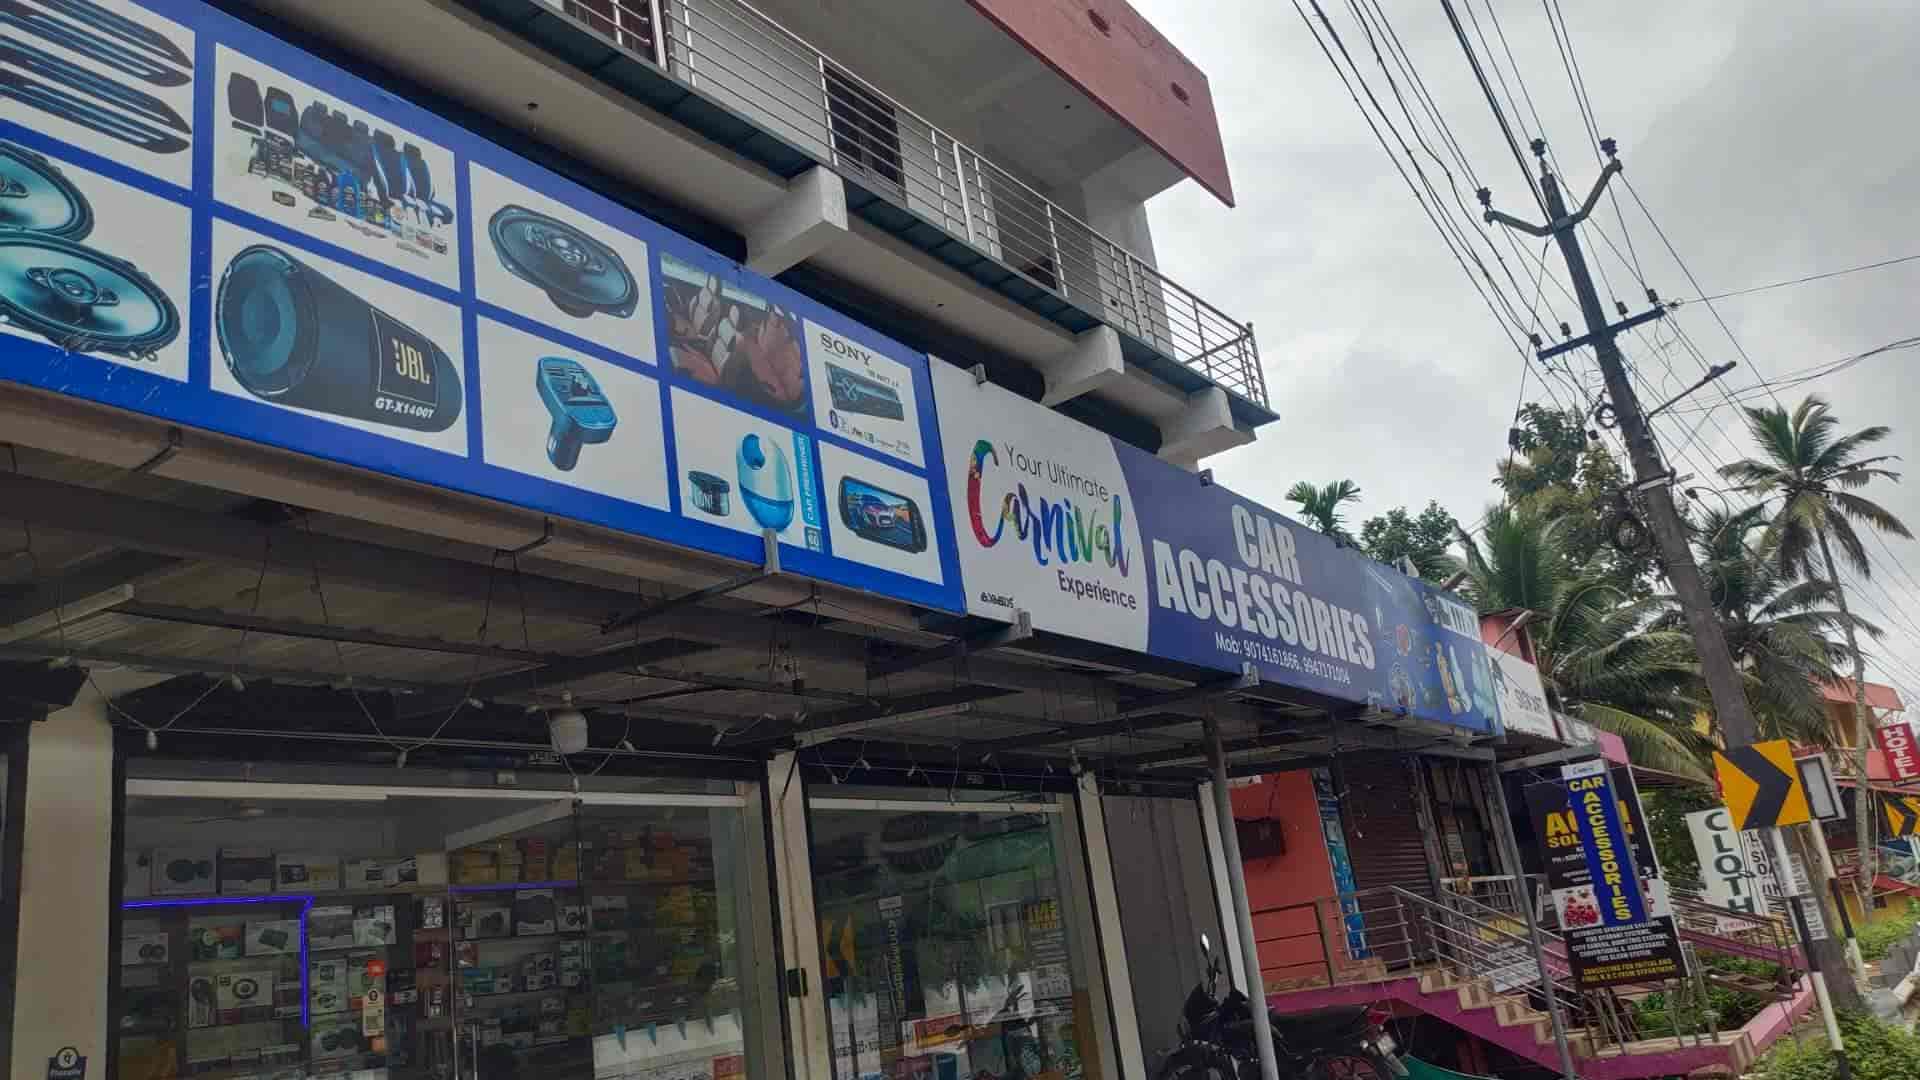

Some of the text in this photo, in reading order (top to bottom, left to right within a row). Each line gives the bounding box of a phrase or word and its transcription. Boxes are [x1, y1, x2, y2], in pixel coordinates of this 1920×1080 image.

[392, 338, 430, 384] JBL
[820, 333, 872, 366] SONY
[1004, 442, 1109, 502] Your Ultimate
[968, 440, 1130, 577] Carnival
[1231, 503, 1304, 585] CAR
[1057, 569, 1137, 610] Experience
[1152, 538, 1376, 670] ACCESSORIES
[1215, 631, 1242, 655] Mob:
[1881, 727, 1919, 778] HOTEL
[1568, 776, 1605, 792] CAR
[1583, 791, 1632, 921] ACCESSORIES
